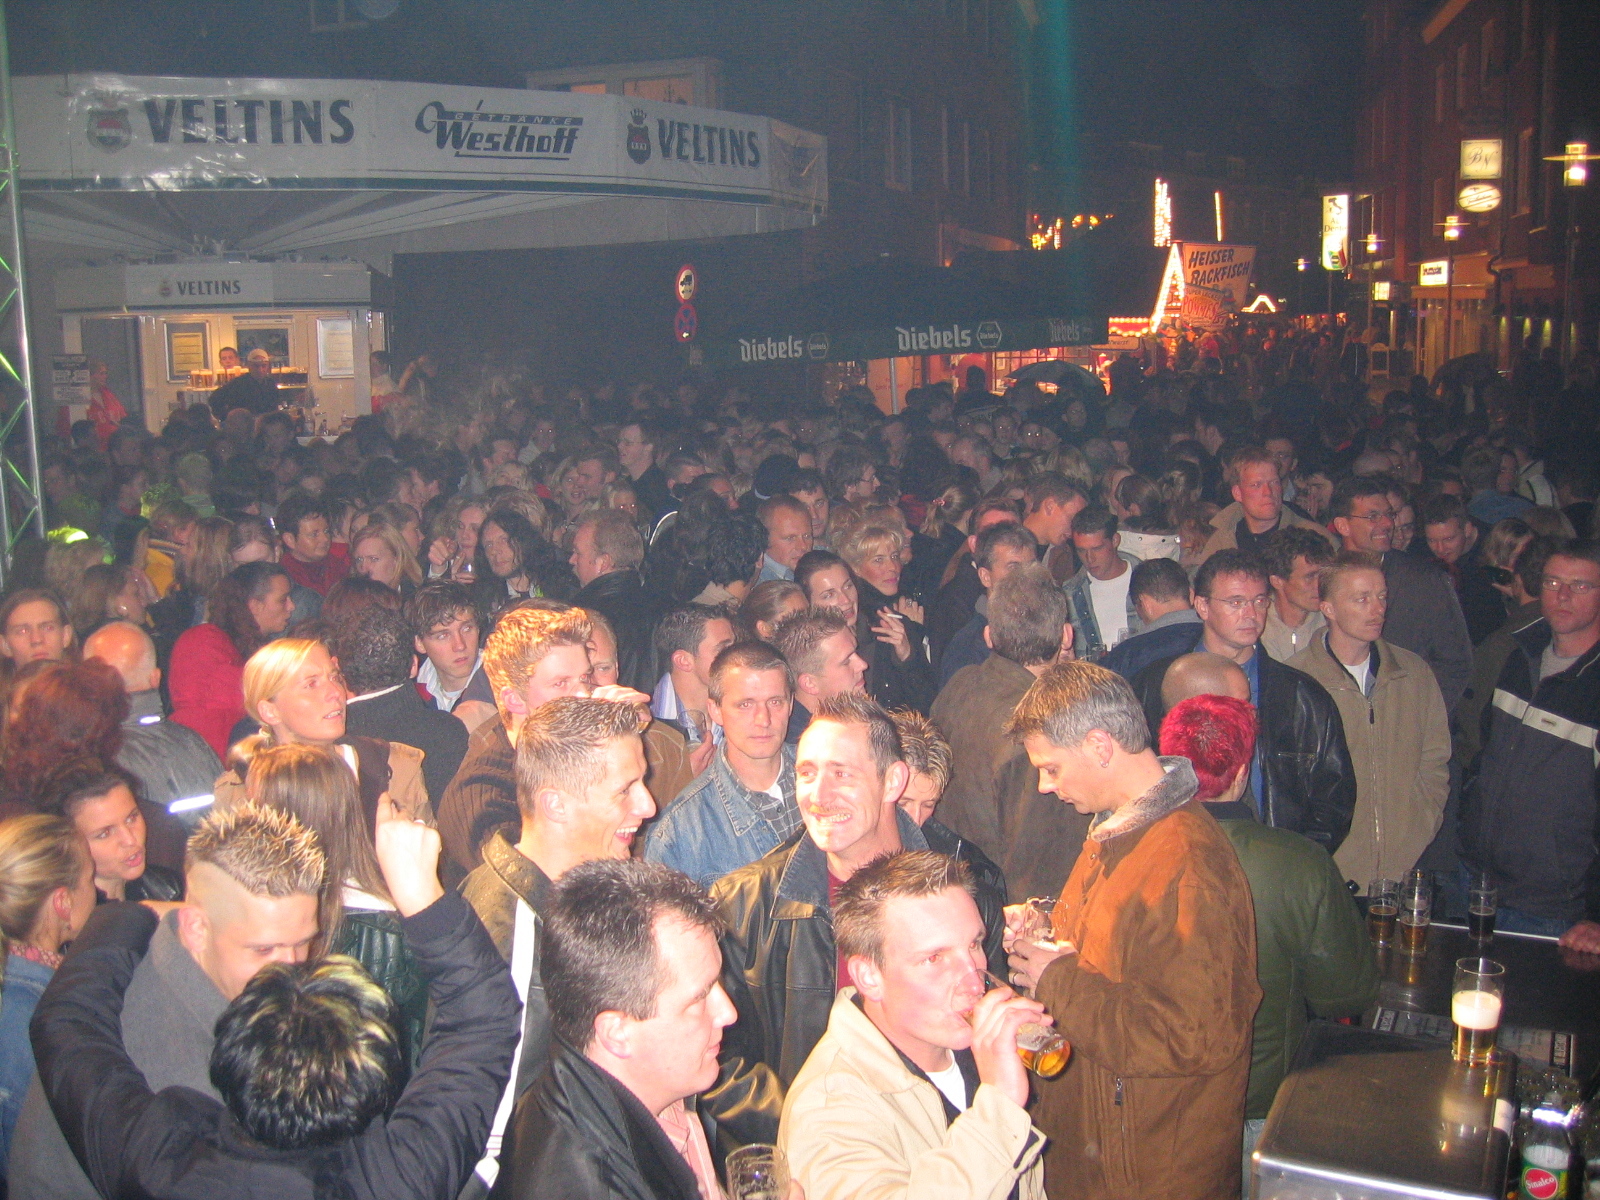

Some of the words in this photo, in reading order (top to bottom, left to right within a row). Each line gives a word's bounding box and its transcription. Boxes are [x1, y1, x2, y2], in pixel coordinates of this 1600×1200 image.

[144, 99, 355, 144] VELTINS
[455, 111, 573, 125] GETRÄNKE
[415, 110, 579, 154] Westhoff
[657, 119, 760, 168] VELTINS
[1188, 249, 1234, 269] HEISSER
[1191, 261, 1251, 285] BACKFISCH
[177, 280, 241, 295] VELTINS
[738, 335, 803, 362] Diebels
[895, 324, 971, 351] Diebels
[1525, 1176, 1555, 1190] Sinalco
